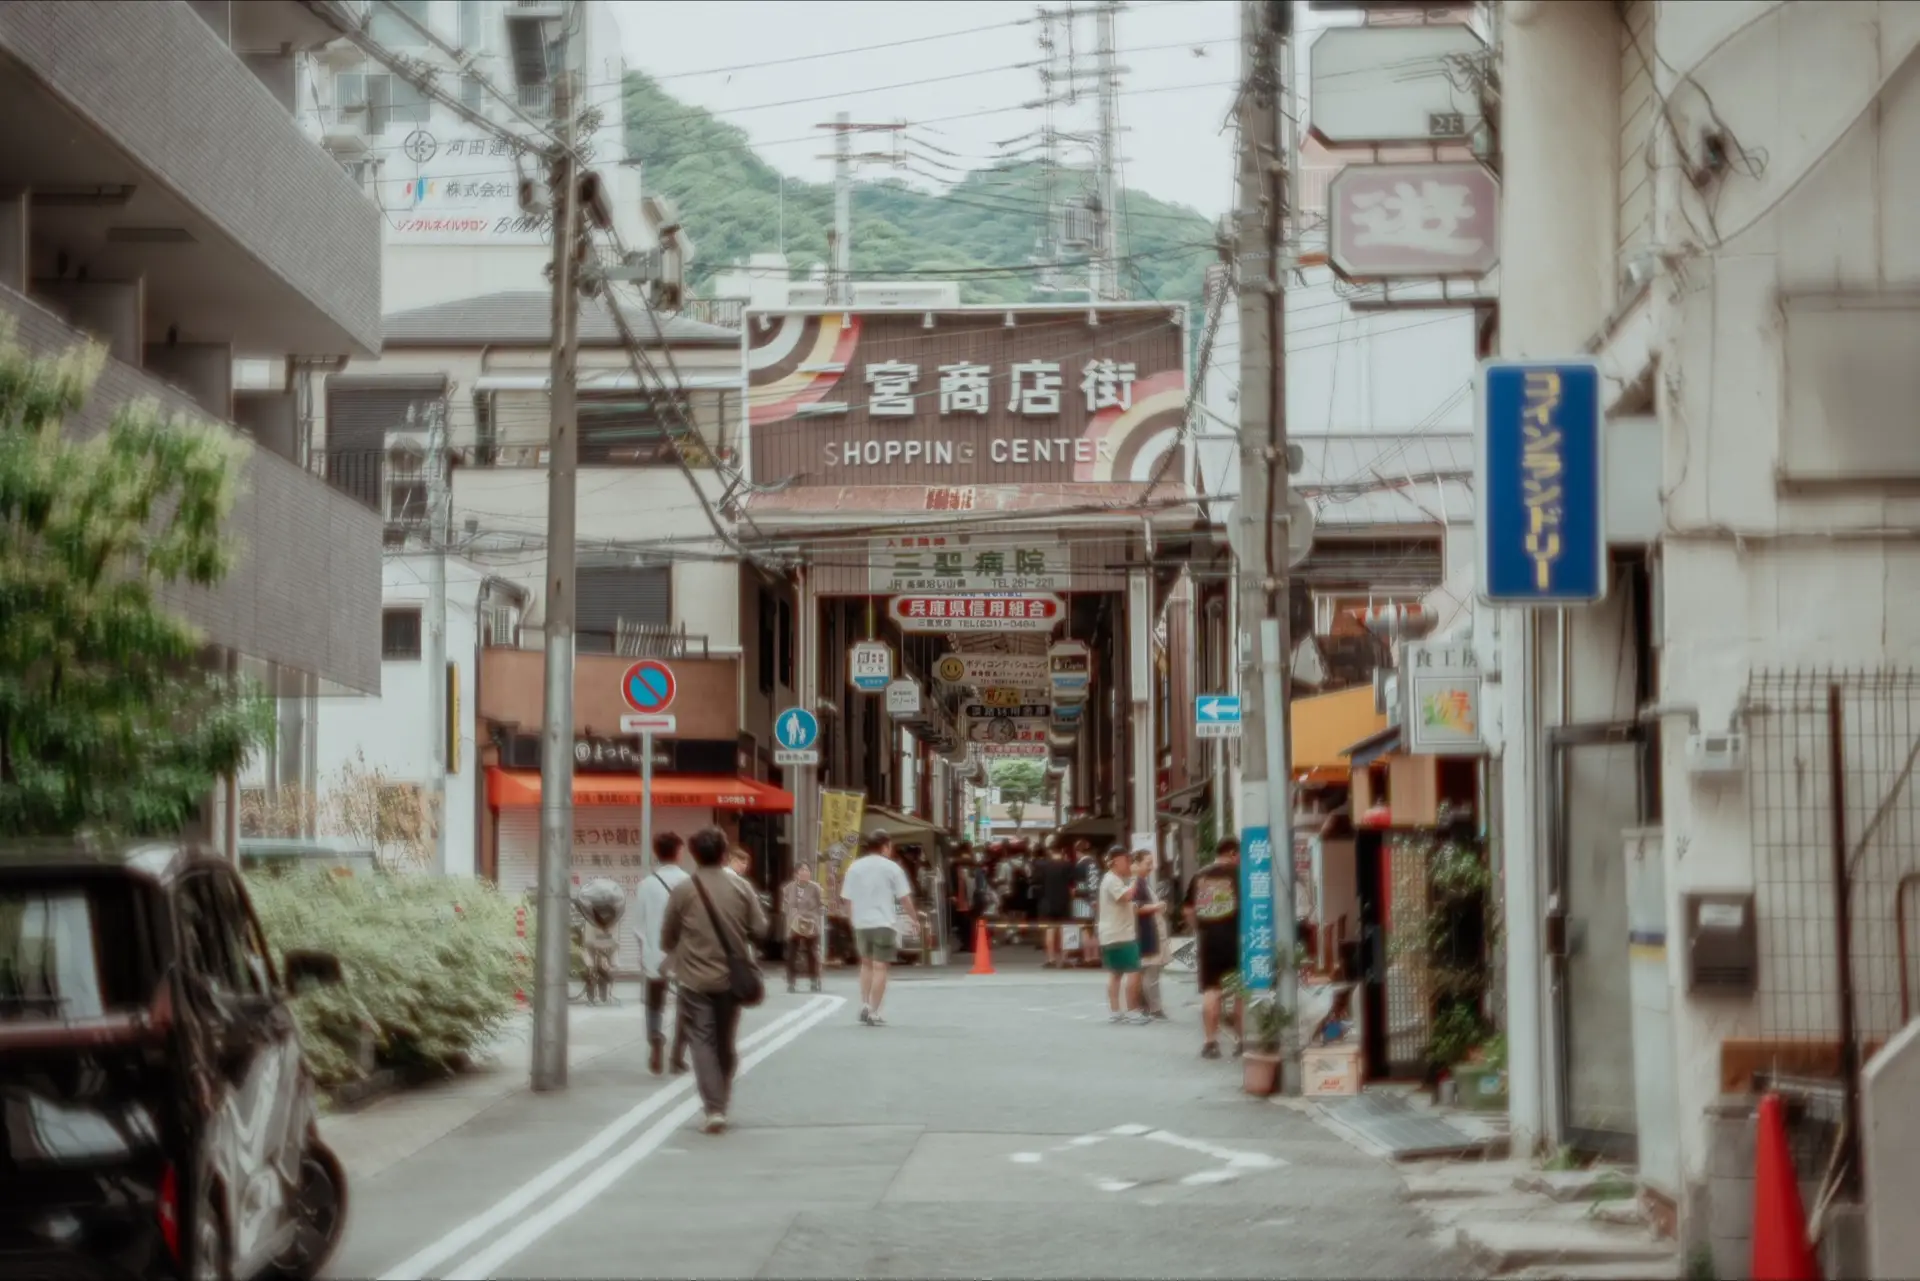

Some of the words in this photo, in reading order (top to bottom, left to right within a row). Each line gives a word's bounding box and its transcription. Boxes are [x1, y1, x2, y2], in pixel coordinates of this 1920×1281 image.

[1433, 116, 1461, 134] 2F
[446, 181, 513, 198] 株式会社
[796, 359, 1136, 415] 二宮商店街
[990, 437, 1114, 464] CENTER
[1522, 371, 1562, 590] コインランドリー
[892, 548, 1046, 577] 三聖病院
[909, 600, 1046, 618] 兵庫県信用組合
[1247, 838, 1272, 979] 学童に注意
